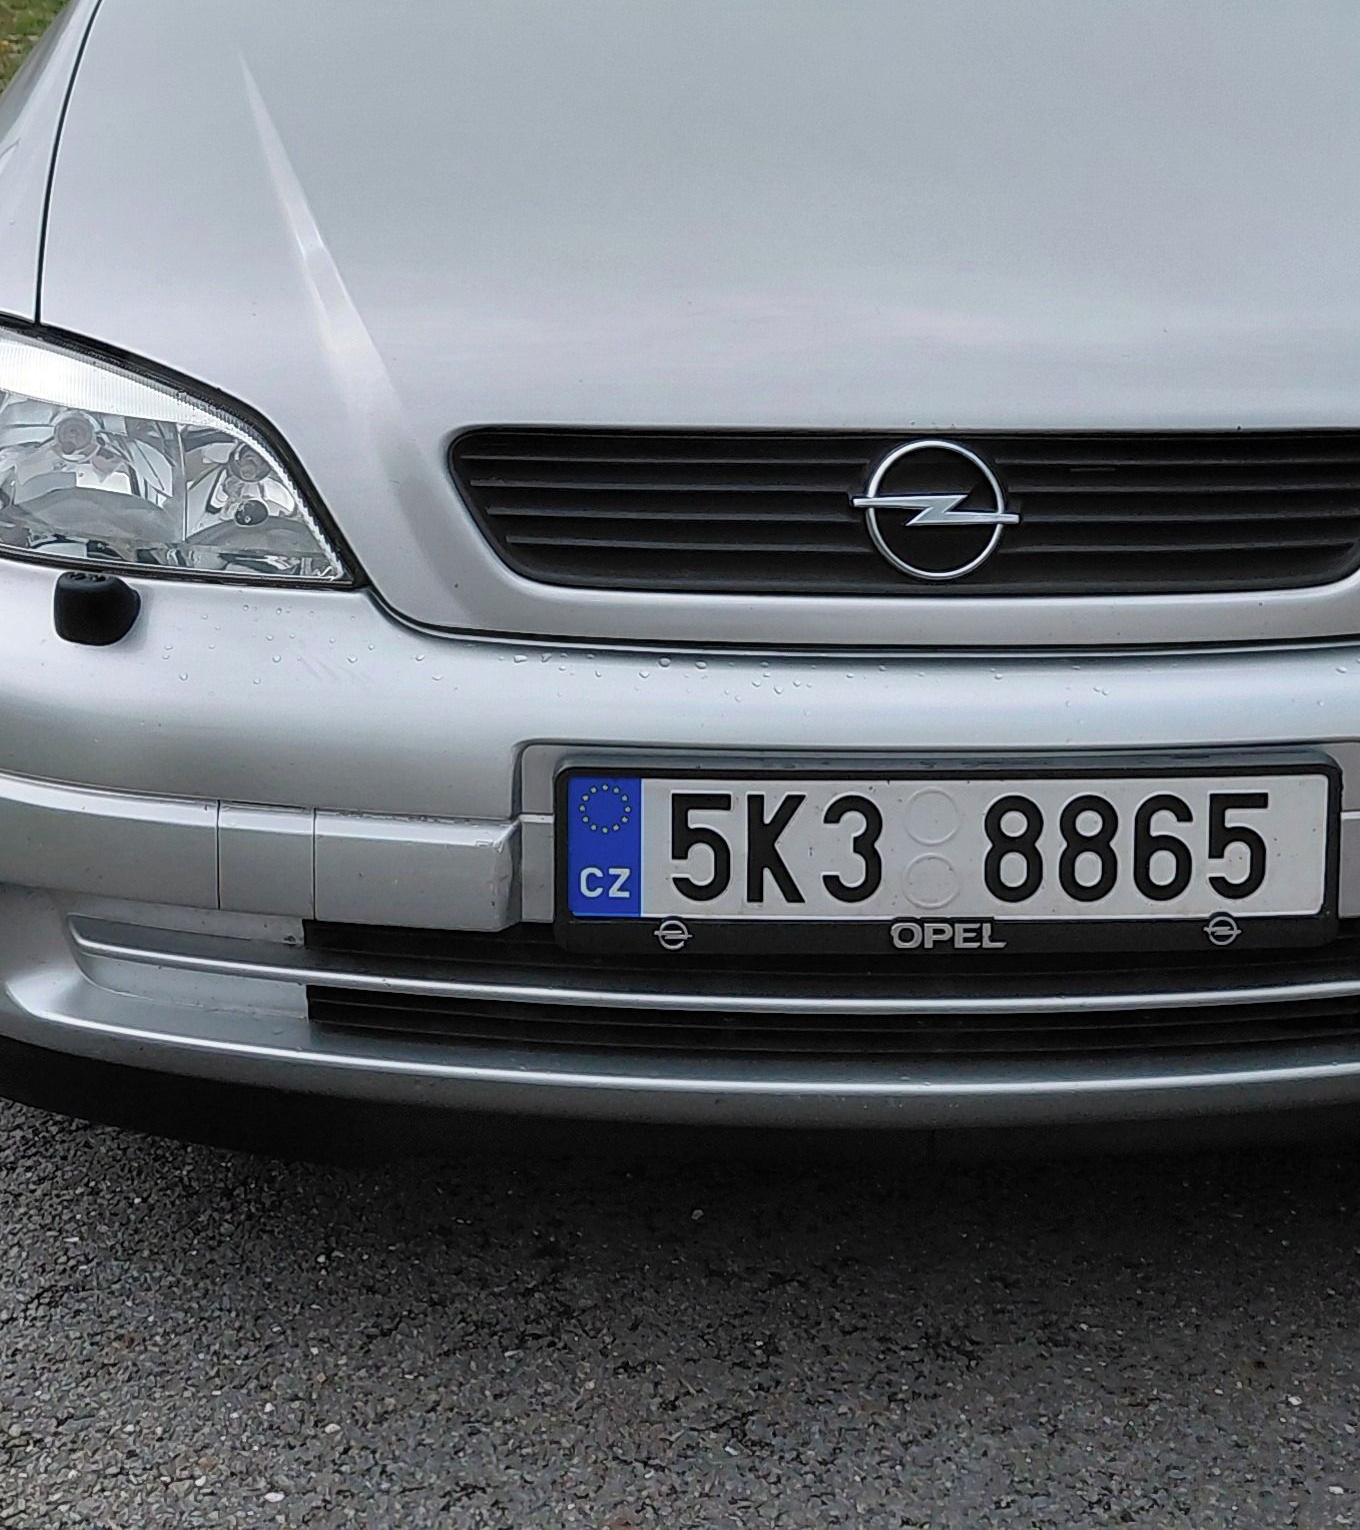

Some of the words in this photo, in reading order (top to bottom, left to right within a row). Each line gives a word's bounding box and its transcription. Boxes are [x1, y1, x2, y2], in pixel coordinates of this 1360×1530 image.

[670, 791, 884, 904] 5K3
[983, 791, 1270, 905] 8865
[579, 867, 632, 900] CZ
[890, 920, 1008, 951] OPEL
